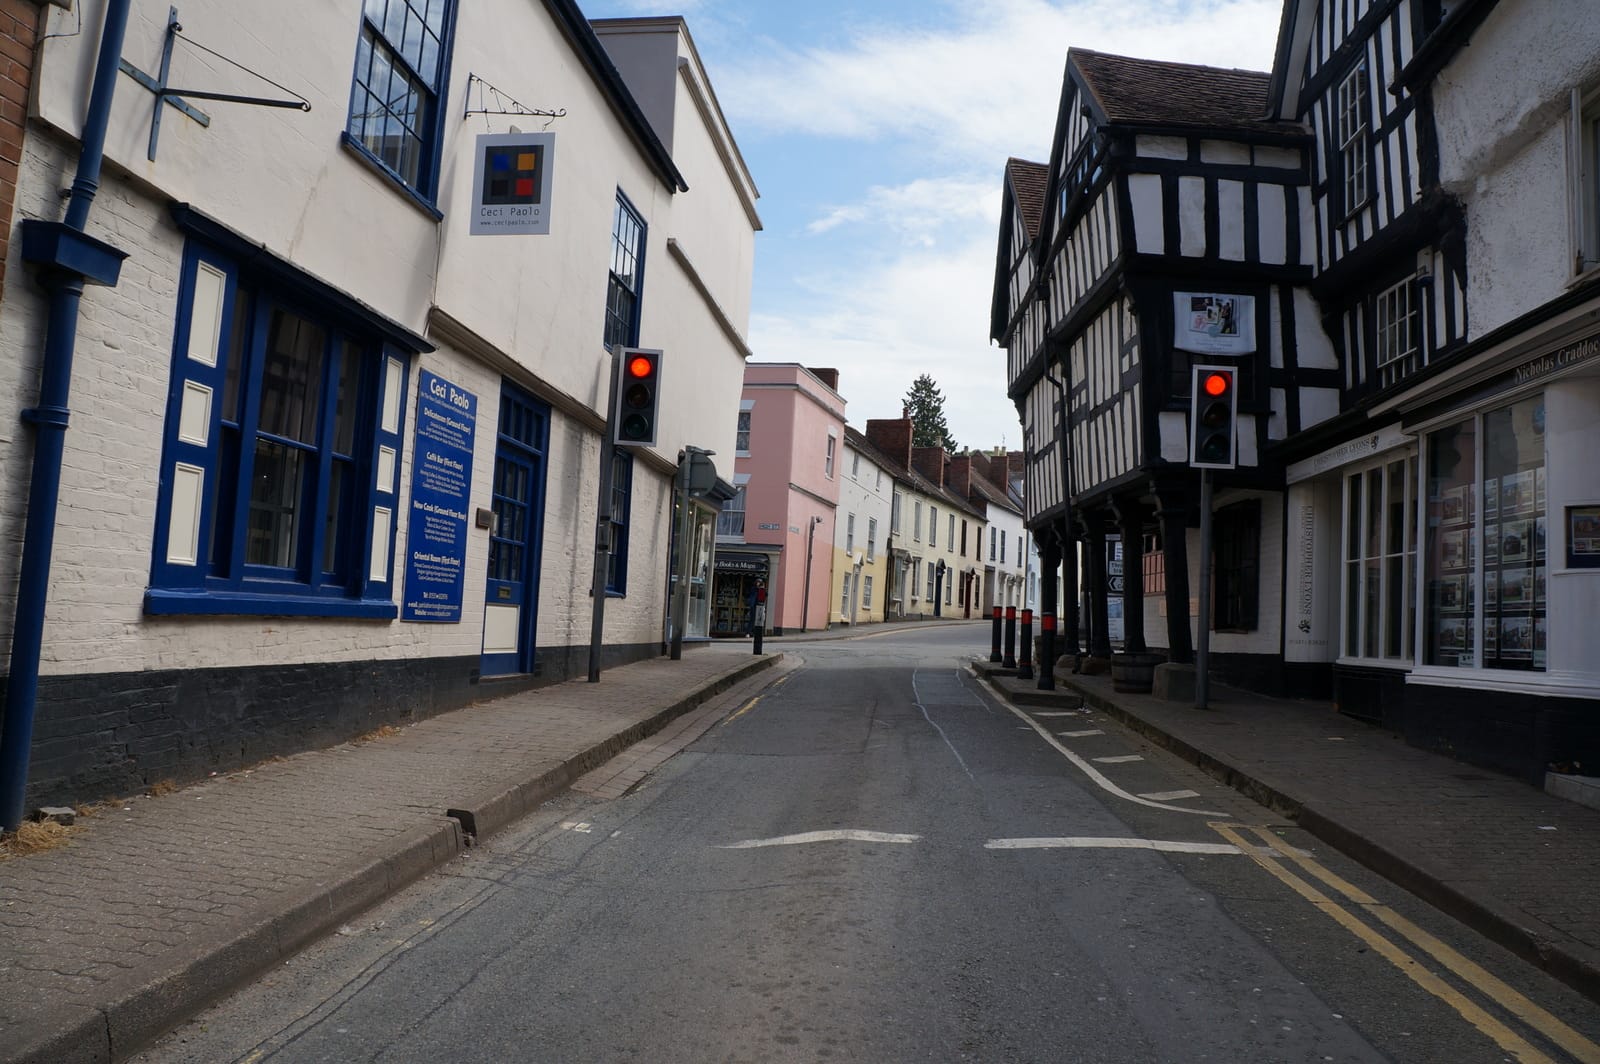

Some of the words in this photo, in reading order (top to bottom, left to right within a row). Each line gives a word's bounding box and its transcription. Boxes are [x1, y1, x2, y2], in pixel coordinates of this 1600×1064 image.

[480, 208, 503, 216] Ceci
[510, 207, 540, 216] Paolo
[1515, 357, 1554, 384] Nicholas
[430, 378, 446, 399] Ceci
[450, 389, 469, 410] Paolo
[1304, 580, 1313, 615] LYONS
